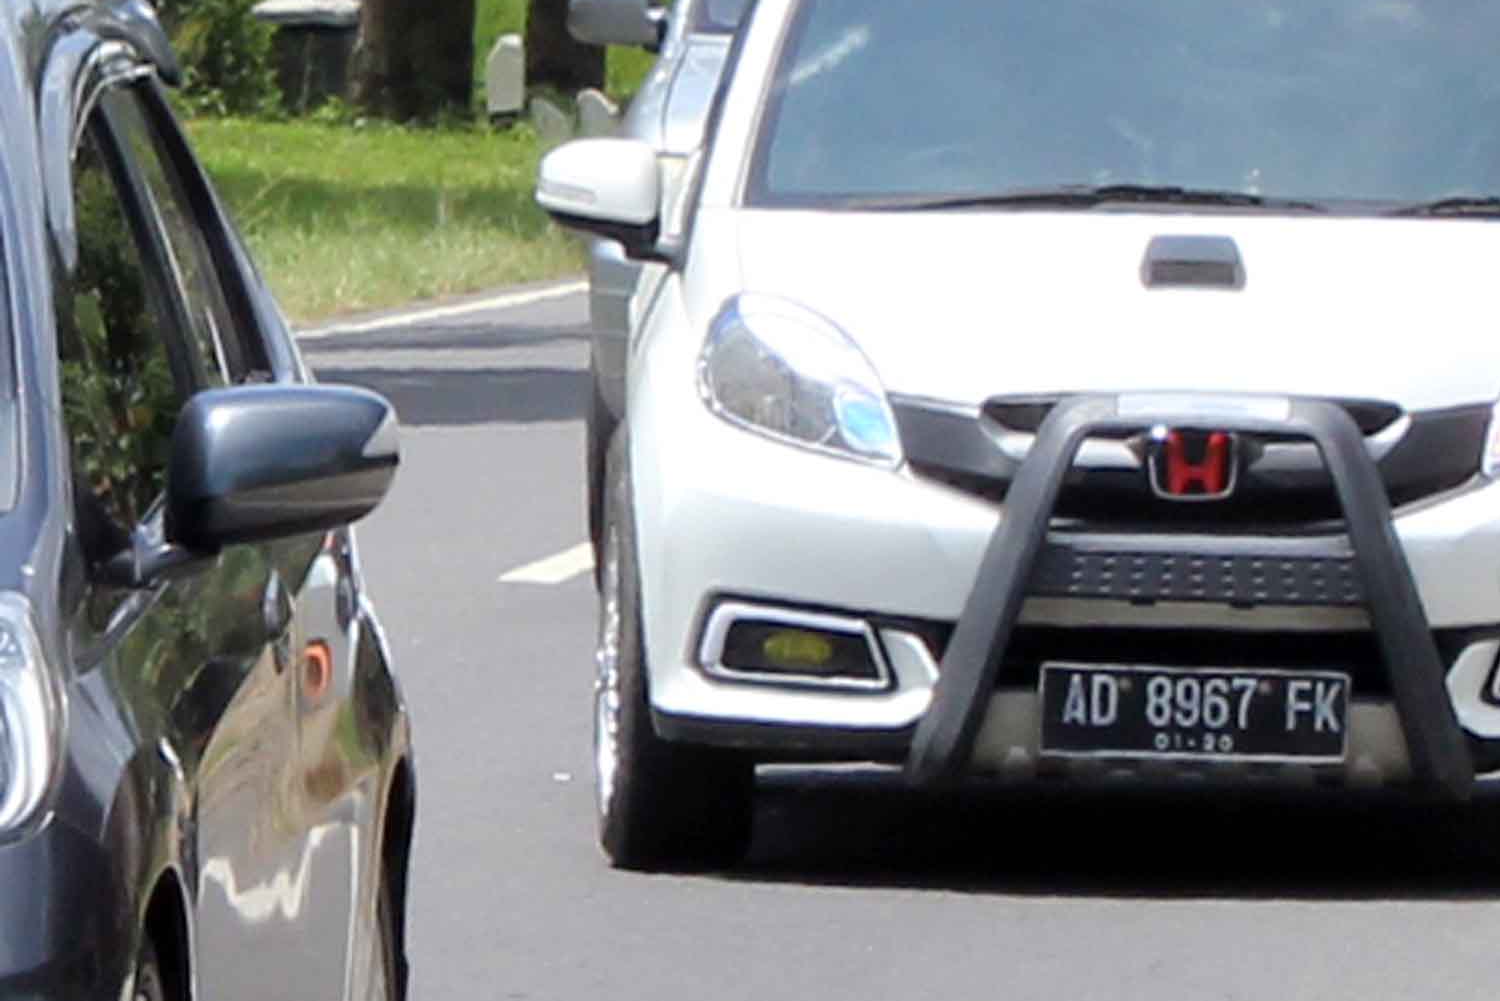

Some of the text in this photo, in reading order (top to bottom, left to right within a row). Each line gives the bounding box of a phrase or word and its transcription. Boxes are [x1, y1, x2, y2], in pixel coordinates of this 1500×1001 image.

[1062, 673, 1344, 733] AD 8967 FK
